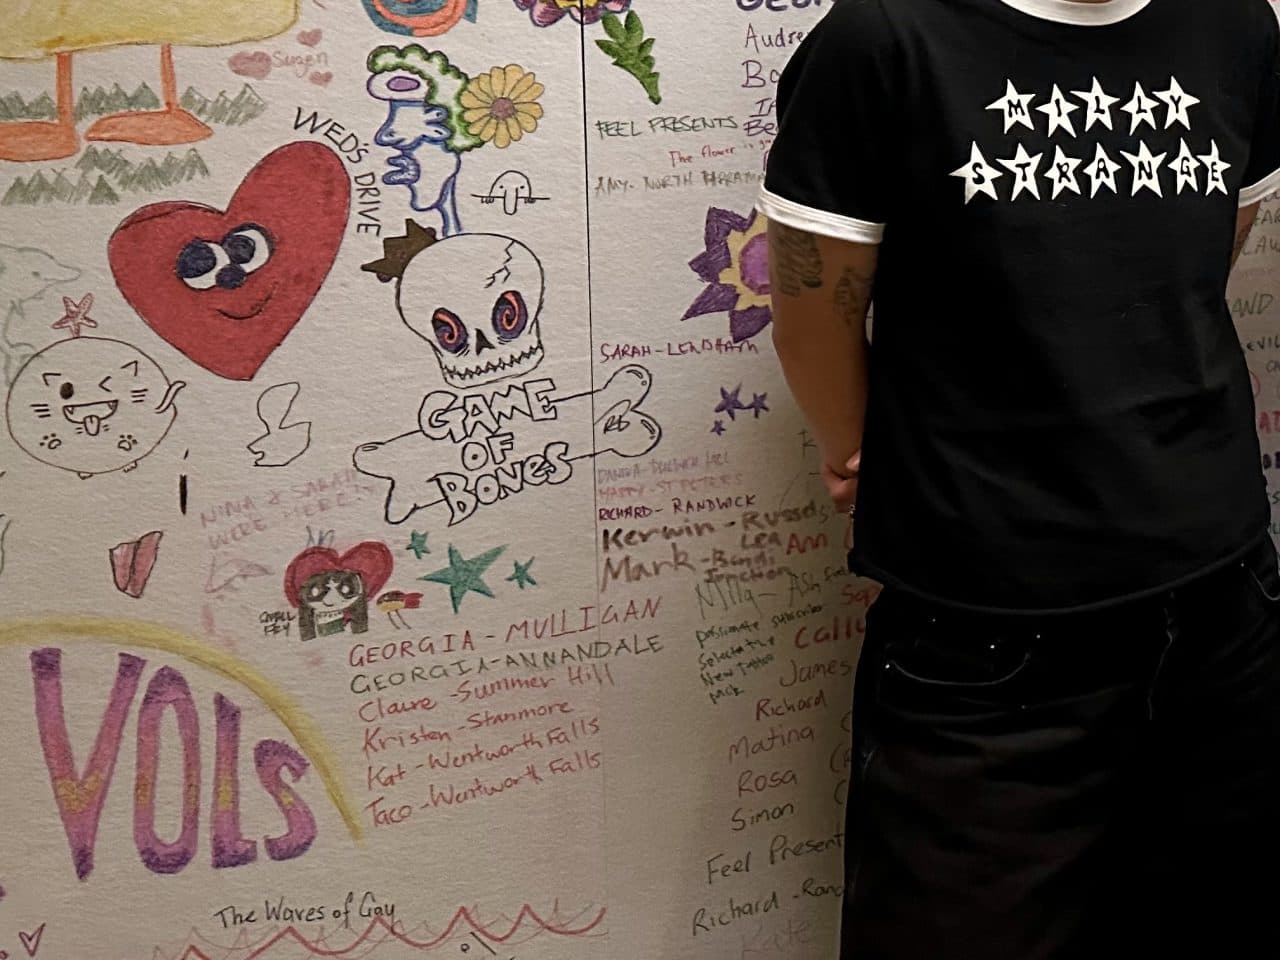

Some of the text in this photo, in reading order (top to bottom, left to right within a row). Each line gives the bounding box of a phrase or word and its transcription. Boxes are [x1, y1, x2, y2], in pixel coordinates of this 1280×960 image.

[351, 172, 382, 237] DRIVE
[418, 378, 558, 443] GAME
[461, 432, 514, 471] OF
[349, 596, 663, 668] GEORGIA MULLIGAN
[567, 663, 616, 687] Hill
[737, 769, 798, 798] Rosa
[705, 851, 753, 887] Feel
[213, 891, 397, 928] The Waves of Gay
[692, 892, 781, 938] Richard
